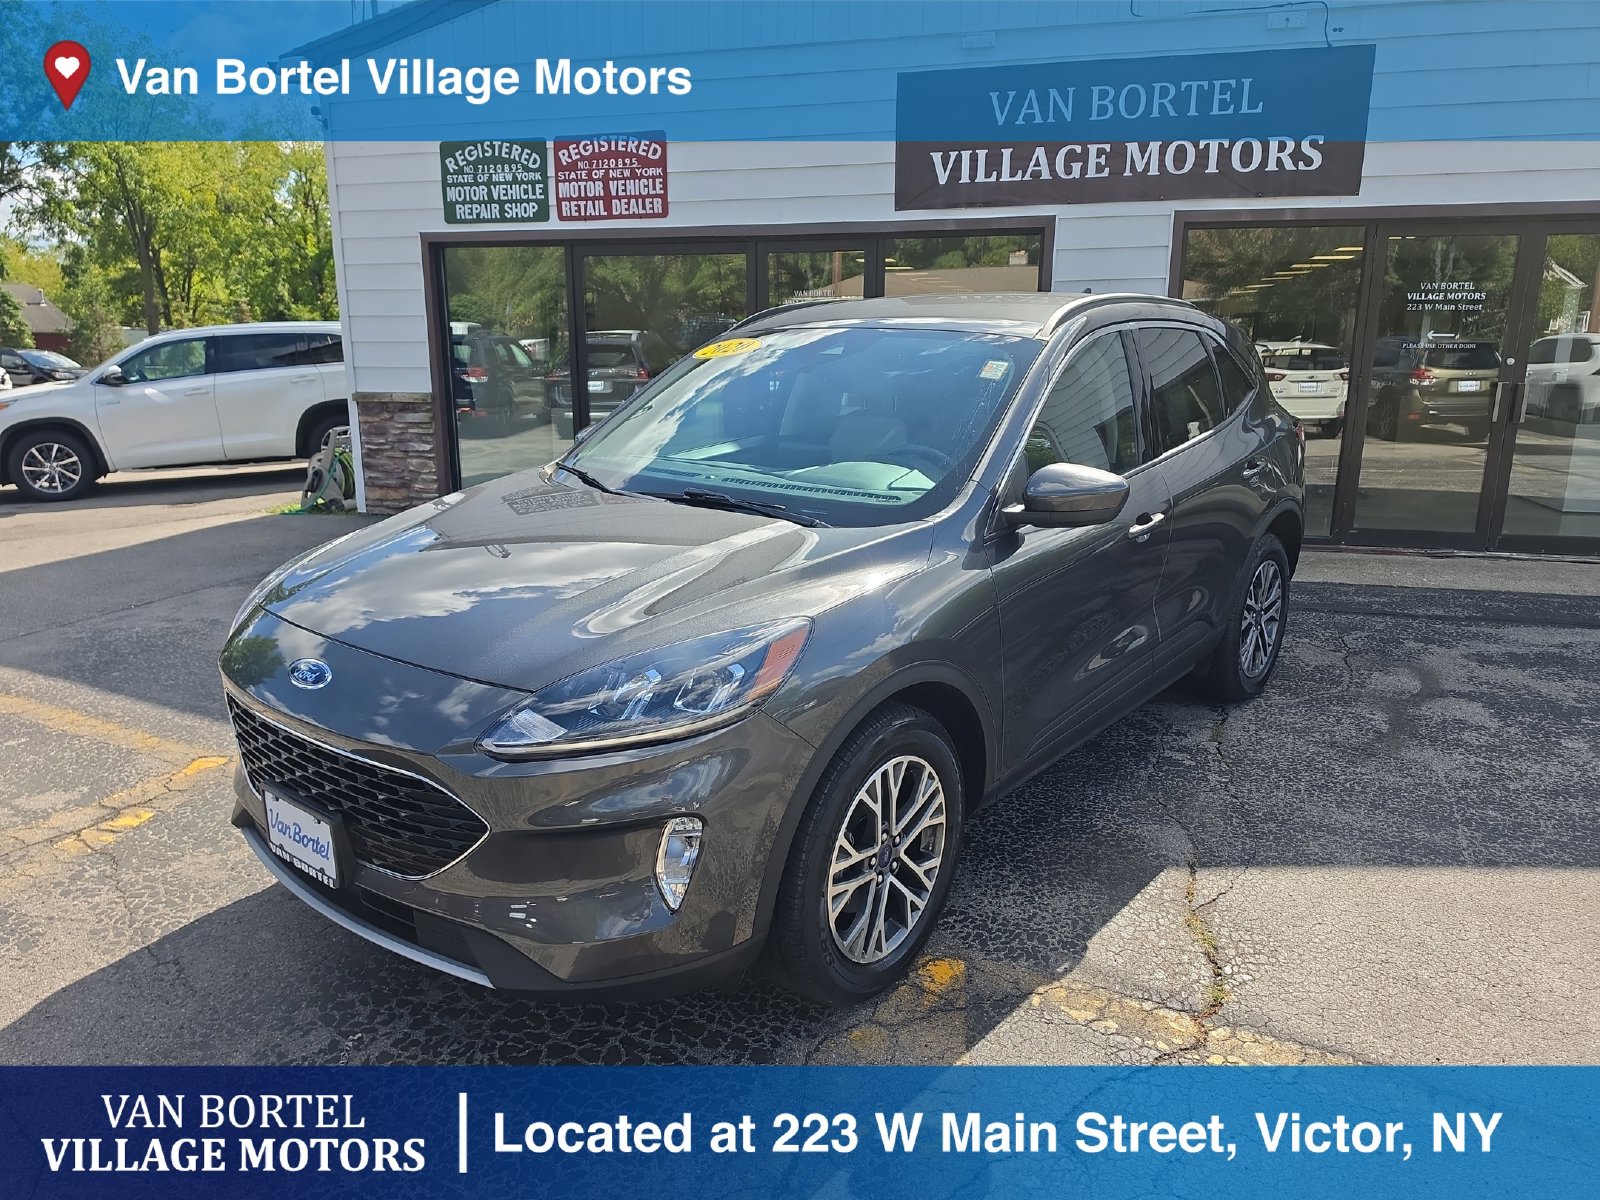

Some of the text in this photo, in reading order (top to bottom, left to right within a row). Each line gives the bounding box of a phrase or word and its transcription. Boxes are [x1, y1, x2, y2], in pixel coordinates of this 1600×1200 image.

[989, 77, 1265, 127] VAN BORTEL
[445, 141, 541, 173] REGISTERED
[558, 135, 662, 166] REGISTERED
[478, 164, 523, 174] 7120895
[591, 158, 639, 169] 7120895
[930, 134, 1326, 186] VILLAGE MOTORS
[446, 171, 542, 183] STATE OF NEW YORK
[558, 167, 664, 180] STATE OF NEW YORK
[446, 183, 545, 202] MOTOR VEHICLE
[558, 178, 665, 199] MOTOR VEHICLE
[455, 202, 539, 220] REPAIR SHOP
[561, 197, 663, 217] RETAIL DEALER
[1420, 281, 1476, 290] VAN BORTEL
[1407, 292, 1487, 300] VILLAGE MOTORS
[1406, 303, 1483, 311] 223 W Main Street
[268, 841, 337, 890] VAN BORTEL
